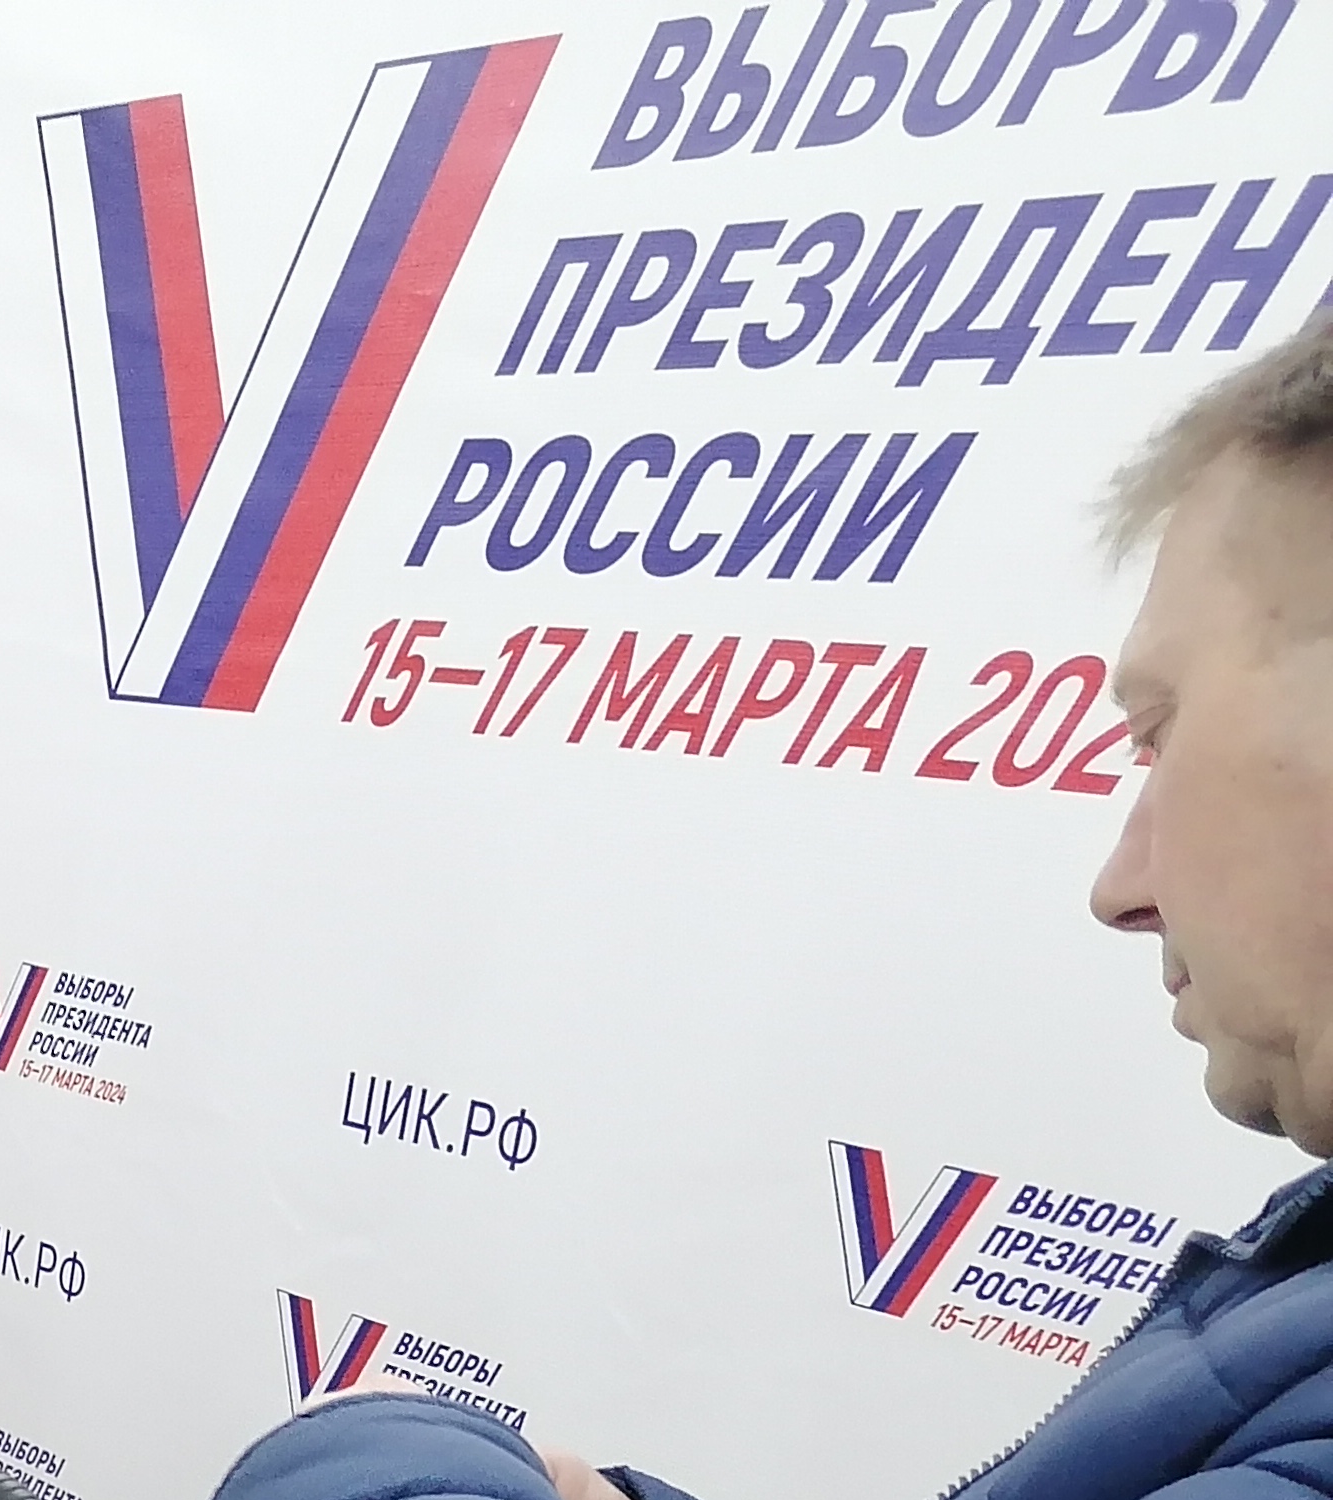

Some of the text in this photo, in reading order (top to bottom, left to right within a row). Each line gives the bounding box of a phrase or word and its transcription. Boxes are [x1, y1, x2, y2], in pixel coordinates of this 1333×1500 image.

[591, 0, 1297, 169] ВЫБОРЫ
[495, 173, 1333, 388] ПРЕЗИДЕН
[405, 431, 978, 584] РОССИИ
[568, 632, 926, 773] МАРТА
[914, 650, 1153, 796] 202
[53, 971, 135, 1010] ВЫБОРЫ
[28, 1031, 100, 1067] РОССИИ
[40, 1001, 153, 1049] ПРЕЗИДЕНТА
[341, 1071, 539, 1172] ЦИК.РФ
[1007, 1184, 1179, 1248] ВЫБОРЫ
[979, 1224, 1167, 1294] ПРЕЗИДЕН
[951, 1265, 1102, 1326] РОССИИ
[393, 1332, 504, 1388] ВЫБОРЫ
[998, 1322, 1091, 1368] МАРТА
